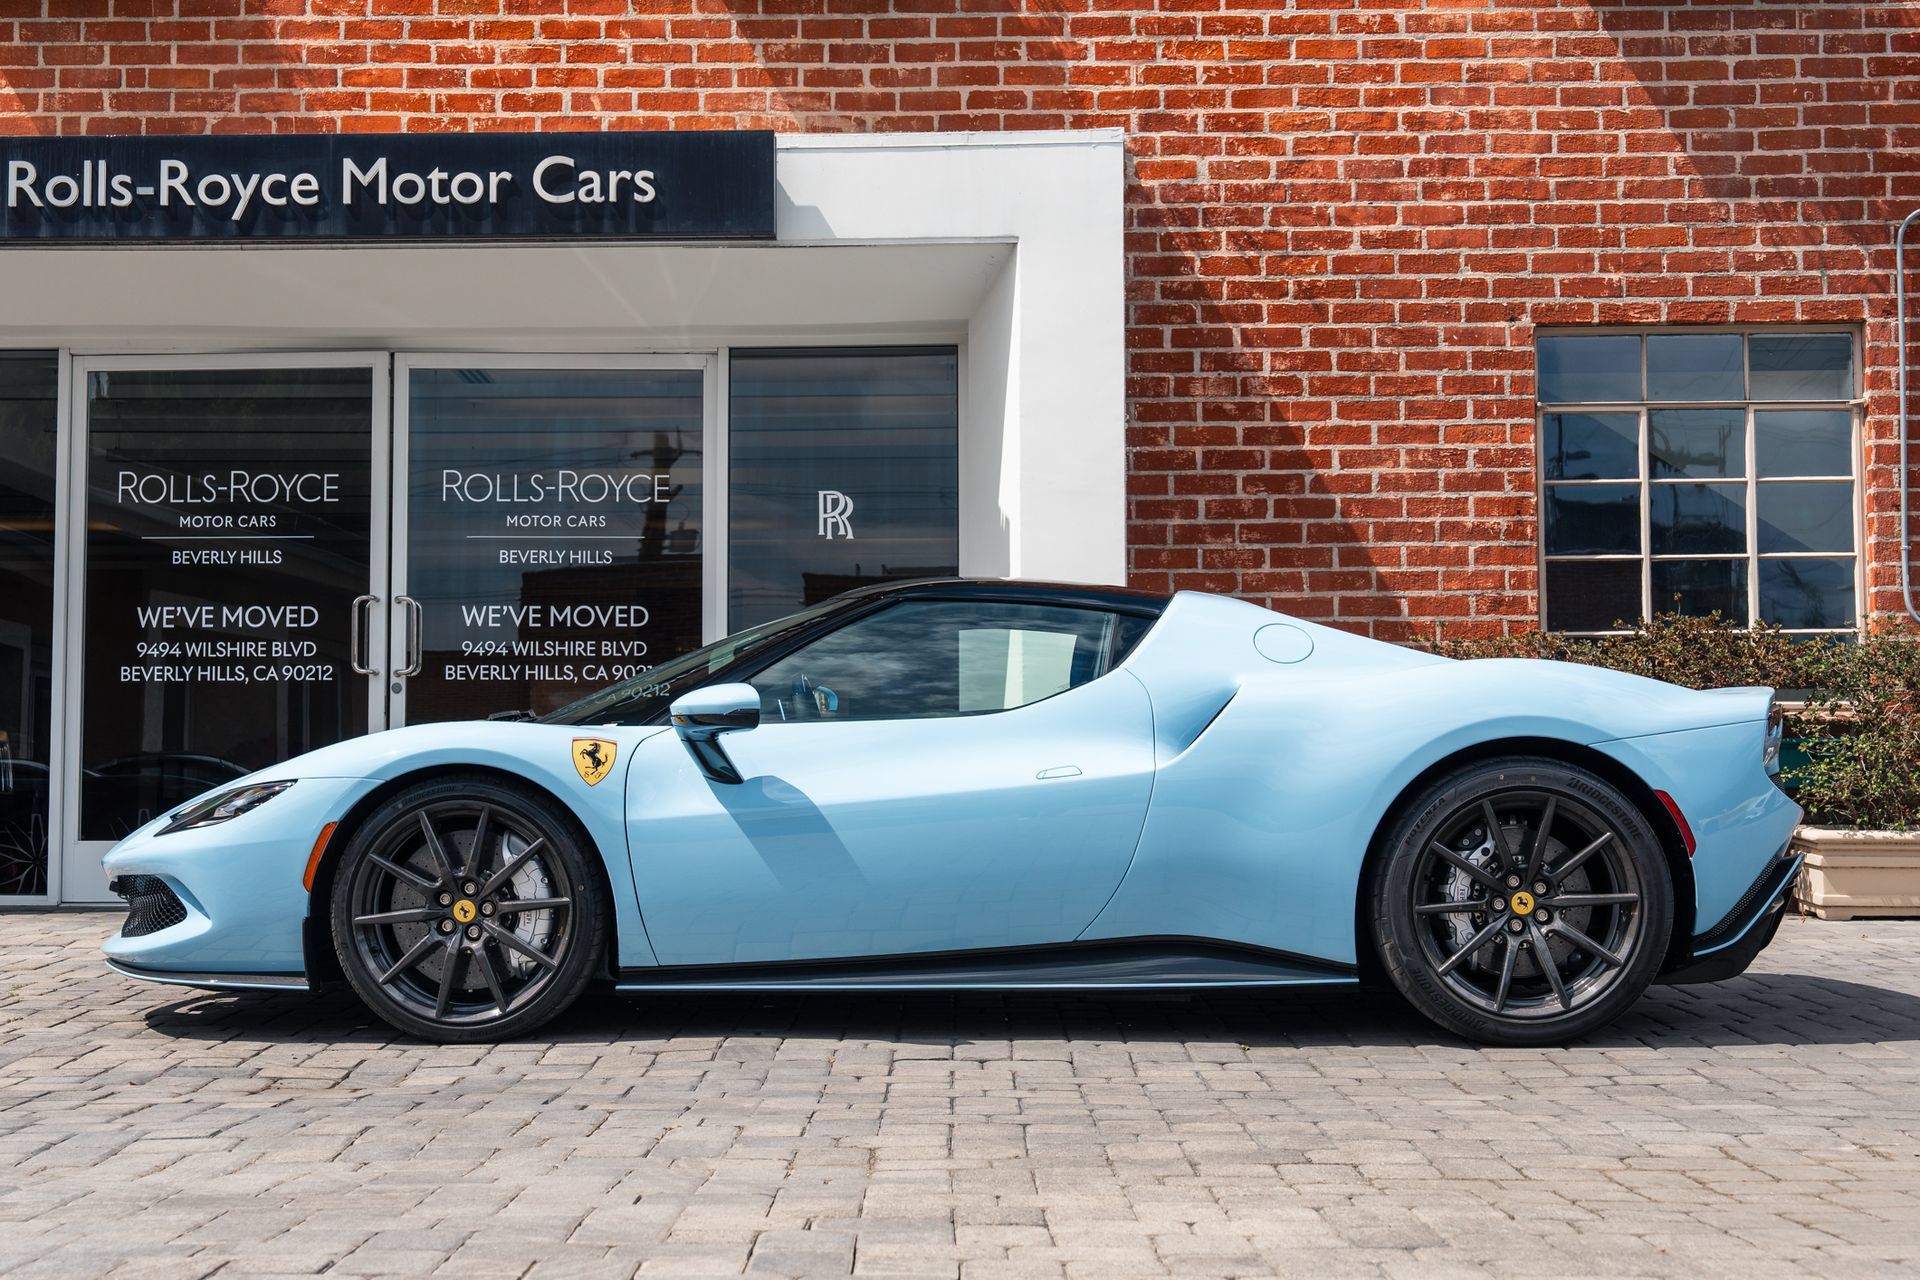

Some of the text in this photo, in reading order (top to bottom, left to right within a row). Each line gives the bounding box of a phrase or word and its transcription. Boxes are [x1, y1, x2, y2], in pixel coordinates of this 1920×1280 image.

[8, 155, 656, 221] Rolls-Royce Motor Cars
[118, 471, 340, 504] ROLLS-ROYCE
[442, 470, 671, 503] ROLLS-ROYCE
[179, 515, 276, 528] MOTOR CARS
[506, 514, 606, 528] MOTOR CARS
[172, 549, 282, 565] BEVERLY HILLS
[499, 549, 613, 565] BEVERLY HILLS
[137, 605, 319, 629] WE'VE MOVED
[461, 605, 649, 628] WE'VE MOVED
[136, 641, 317, 658] 9494 WILSHIRE BLVD
[461, 640, 647, 657] 9494 WILSHIRE BLVD
[120, 664, 333, 685] BEVERLY HILLS, CA 90212
[445, 664, 521, 681] BEVERLY
[525, 664, 578, 684] HILLS,
[582, 664, 609, 681] CA
